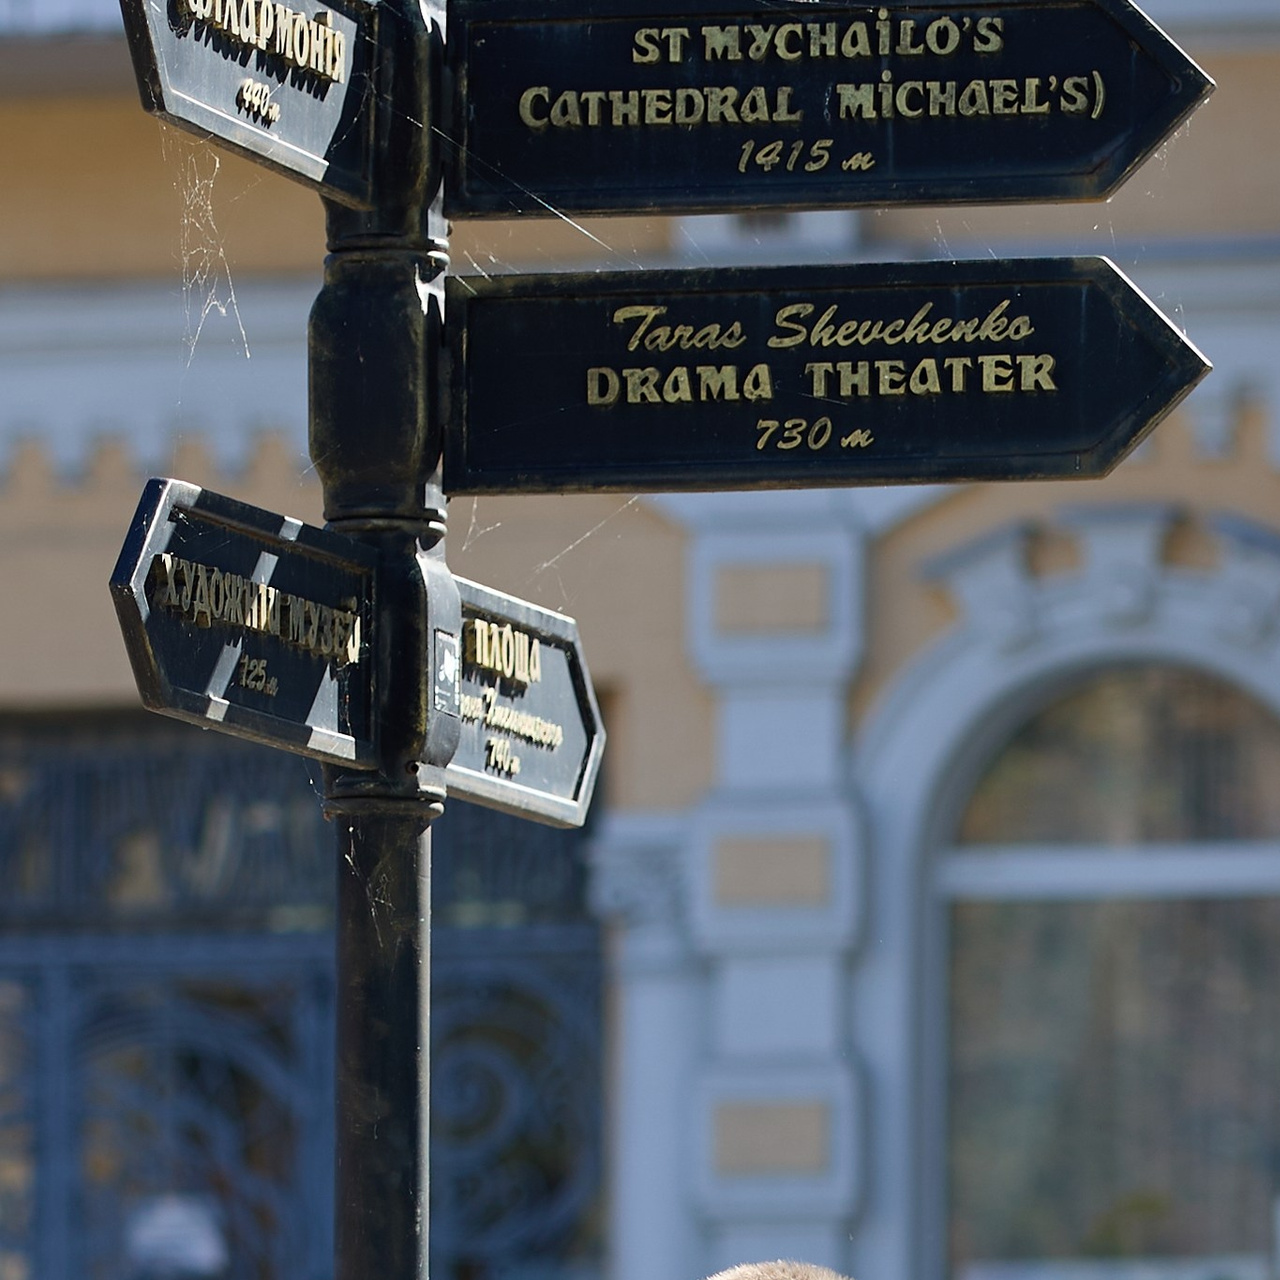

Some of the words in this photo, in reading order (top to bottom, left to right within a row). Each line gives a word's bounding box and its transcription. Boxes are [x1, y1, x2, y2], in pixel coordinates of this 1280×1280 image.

[633, 27, 690, 64] ST
[519, 85, 802, 127] CATHEDRAL
[738, 139, 834, 173] 1415
[613, 305, 747, 351] Taras
[766, 299, 1035, 348] Shevchenko
[587, 362, 773, 405] DRAMA
[804, 353, 1058, 398] THEATER
[756, 416, 832, 450] 730
[474, 618, 541, 683] ПЛОЩА
[241, 654, 267, 690] 125
